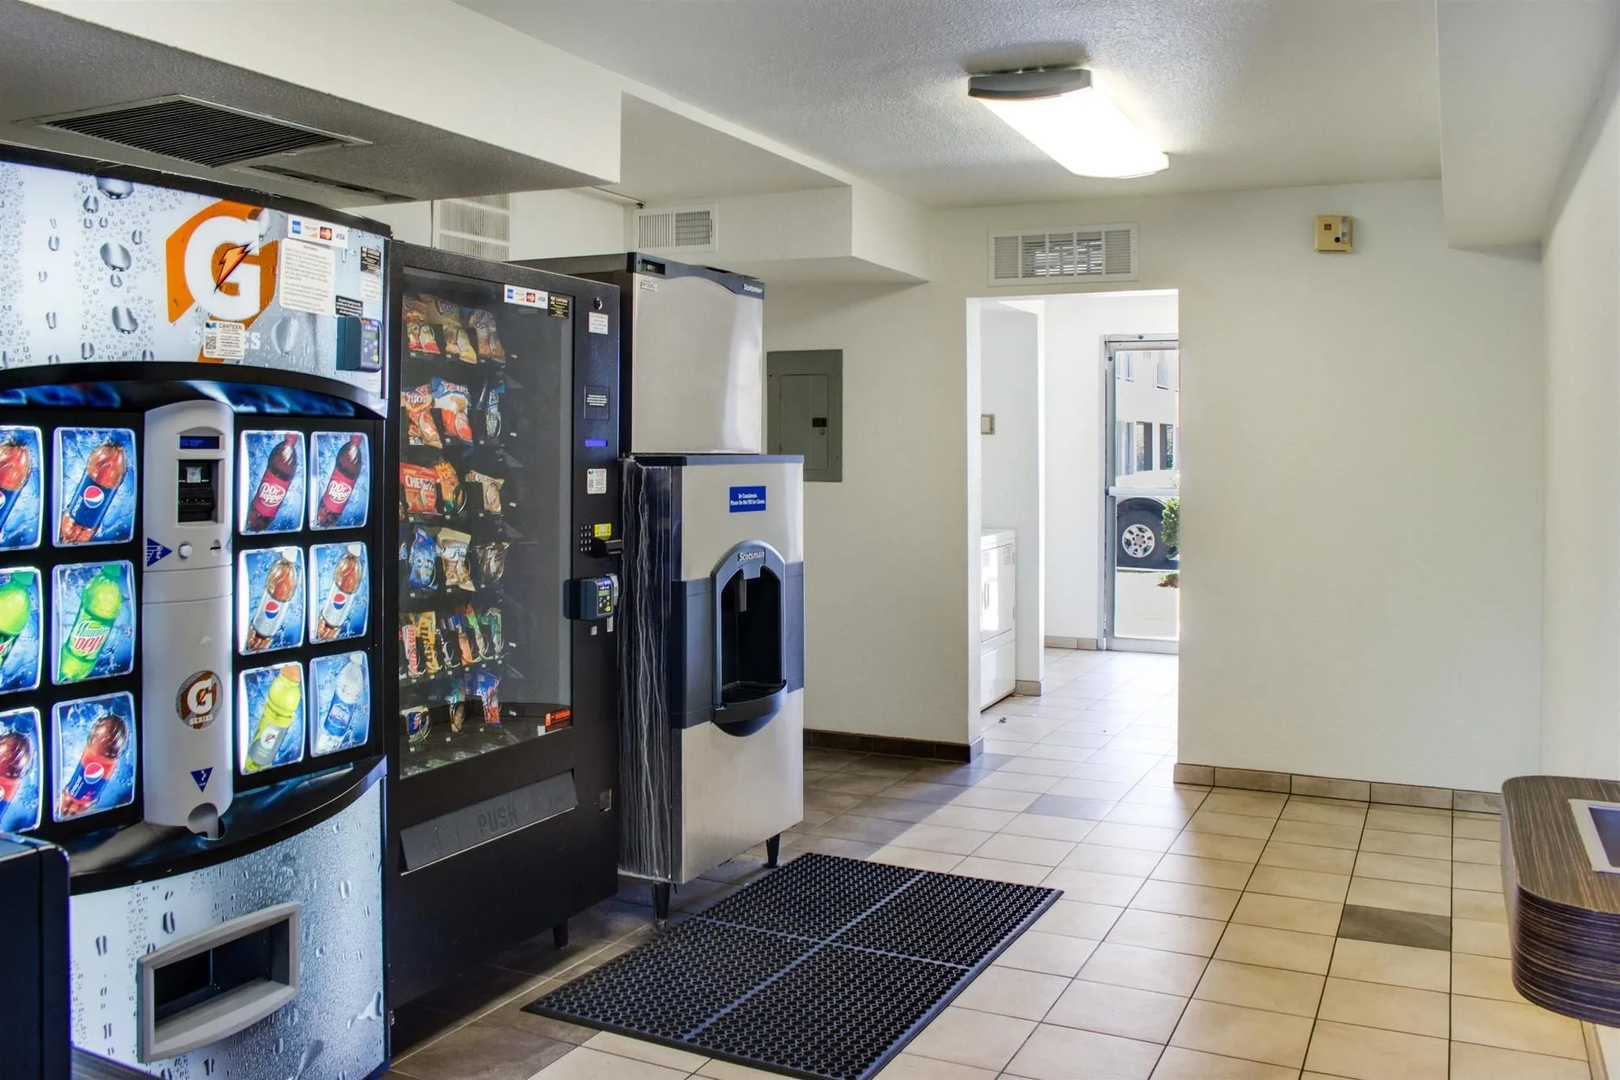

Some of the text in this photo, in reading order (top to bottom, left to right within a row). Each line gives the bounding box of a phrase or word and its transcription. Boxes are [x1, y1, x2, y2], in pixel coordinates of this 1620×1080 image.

[184, 215, 261, 321] G
[219, 322, 243, 330] CANTEEN
[738, 551, 765, 562] Scotsman
[187, 679, 212, 715] G
[477, 803, 518, 836] PUSH
